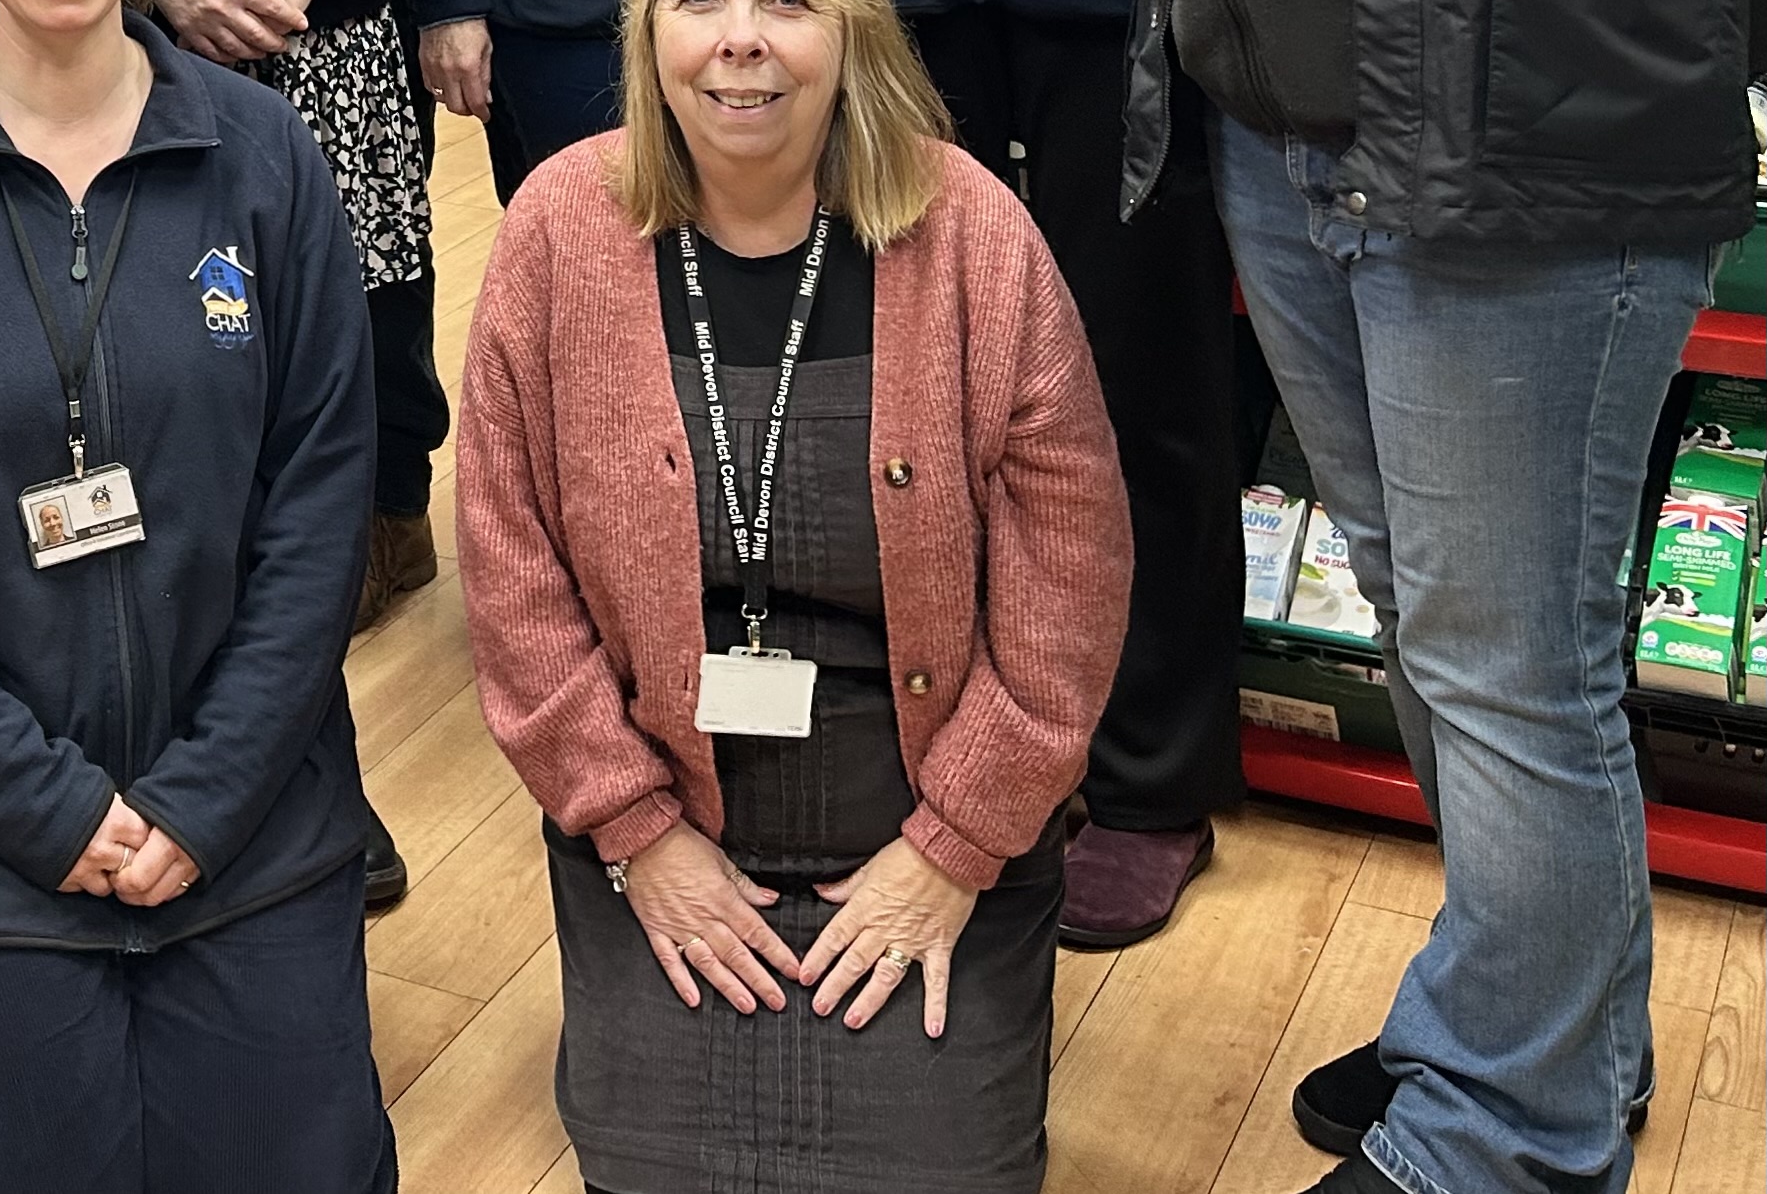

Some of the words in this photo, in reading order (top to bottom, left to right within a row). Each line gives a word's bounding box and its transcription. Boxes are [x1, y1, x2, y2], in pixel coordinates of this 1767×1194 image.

[806, 216, 831, 266] Devon
[684, 261, 704, 297] Staff
[799, 269, 817, 297] Mid
[206, 313, 251, 332] CHAT
[694, 321, 713, 350] Mid
[785, 319, 805, 356] Staff
[699, 353, 719, 402] Devon
[771, 358, 795, 417] Council
[709, 405, 732, 462] District
[760, 419, 782, 476] District
[720, 464, 745, 525] Council
[754, 479, 772, 529] Devon
[751, 532, 768, 561] Mid
[1664, 544, 1702, 558] LONG
[1704, 549, 1732, 561] LIFE
